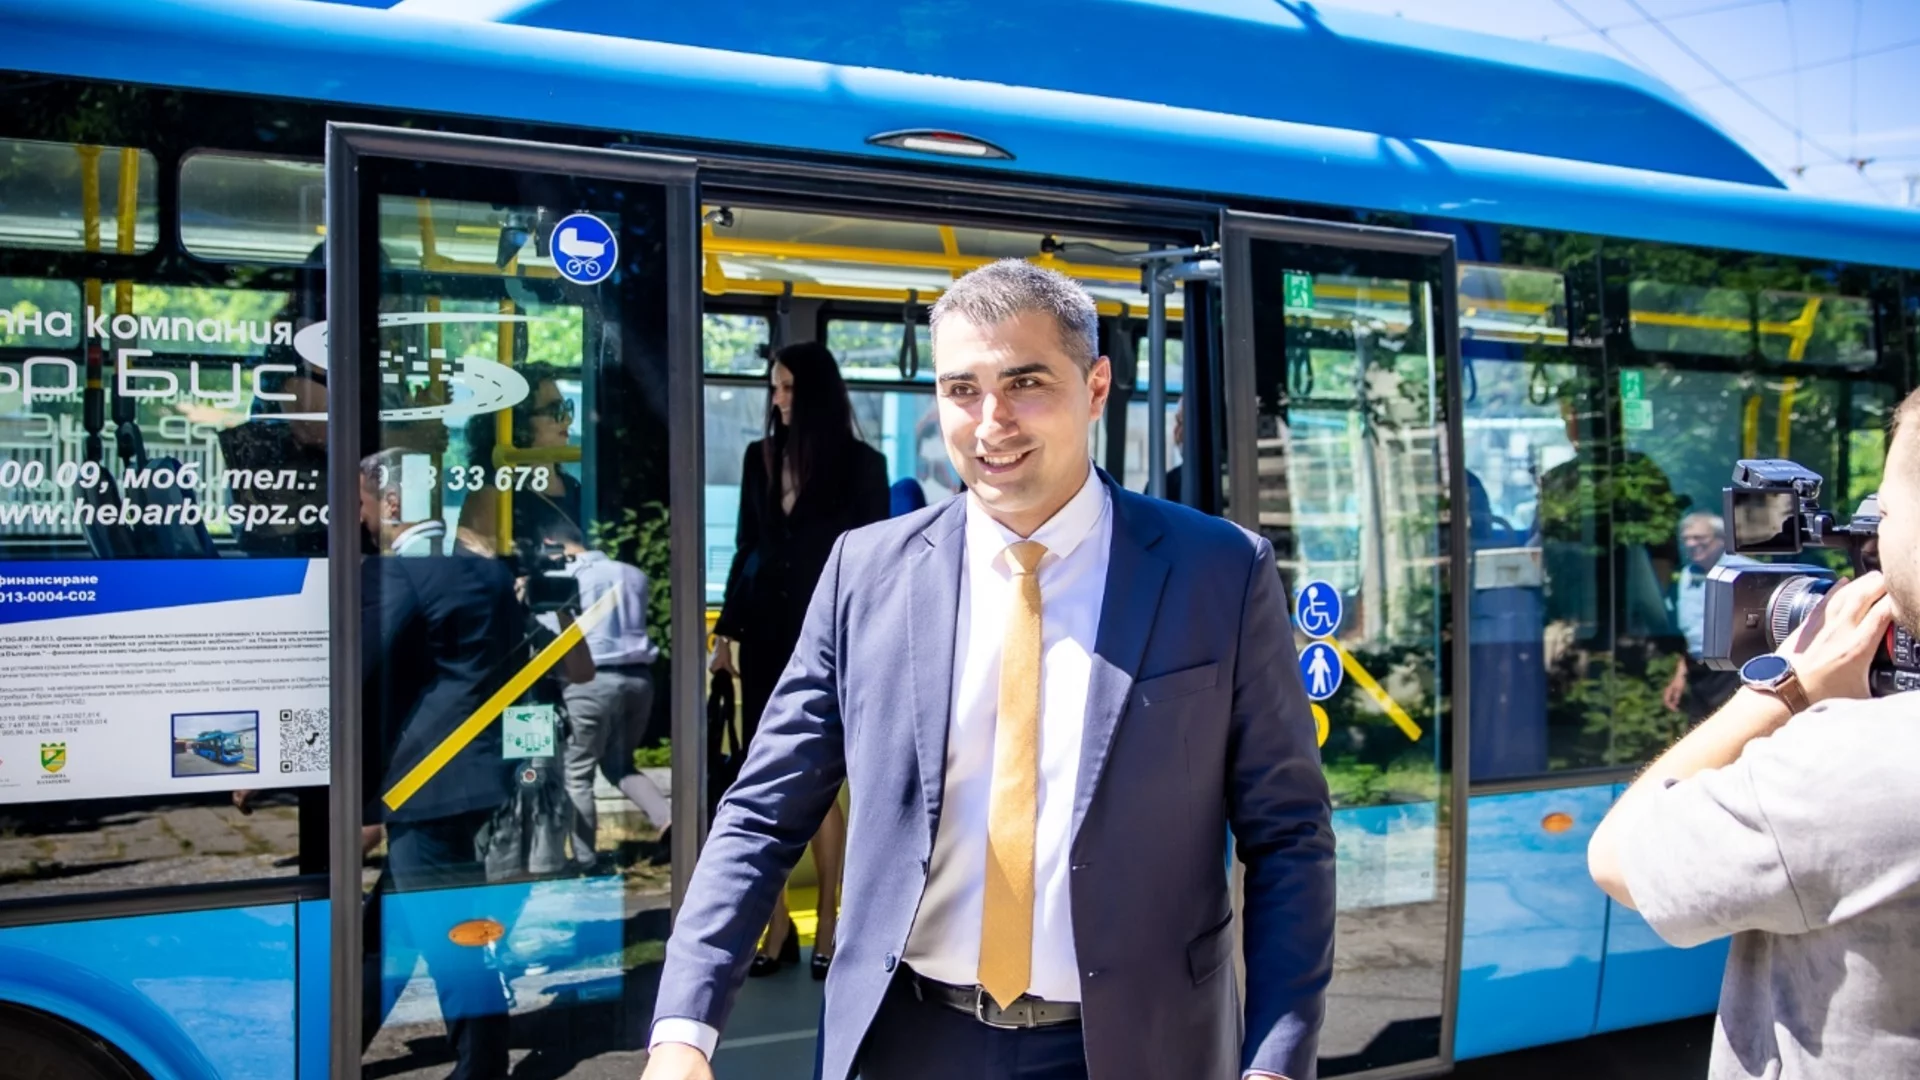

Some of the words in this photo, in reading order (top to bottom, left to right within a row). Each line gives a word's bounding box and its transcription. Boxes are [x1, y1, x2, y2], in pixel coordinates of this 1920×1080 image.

[87, 305, 294, 346] компания
[118, 348, 297, 407] Бус
[0, 460, 44, 489] 00
[56, 460, 109, 494] 09,
[123, 460, 207, 489] моб.
[222, 468, 319, 490] тел.:
[448, 465, 485, 492] 33
[494, 465, 550, 492] 678
